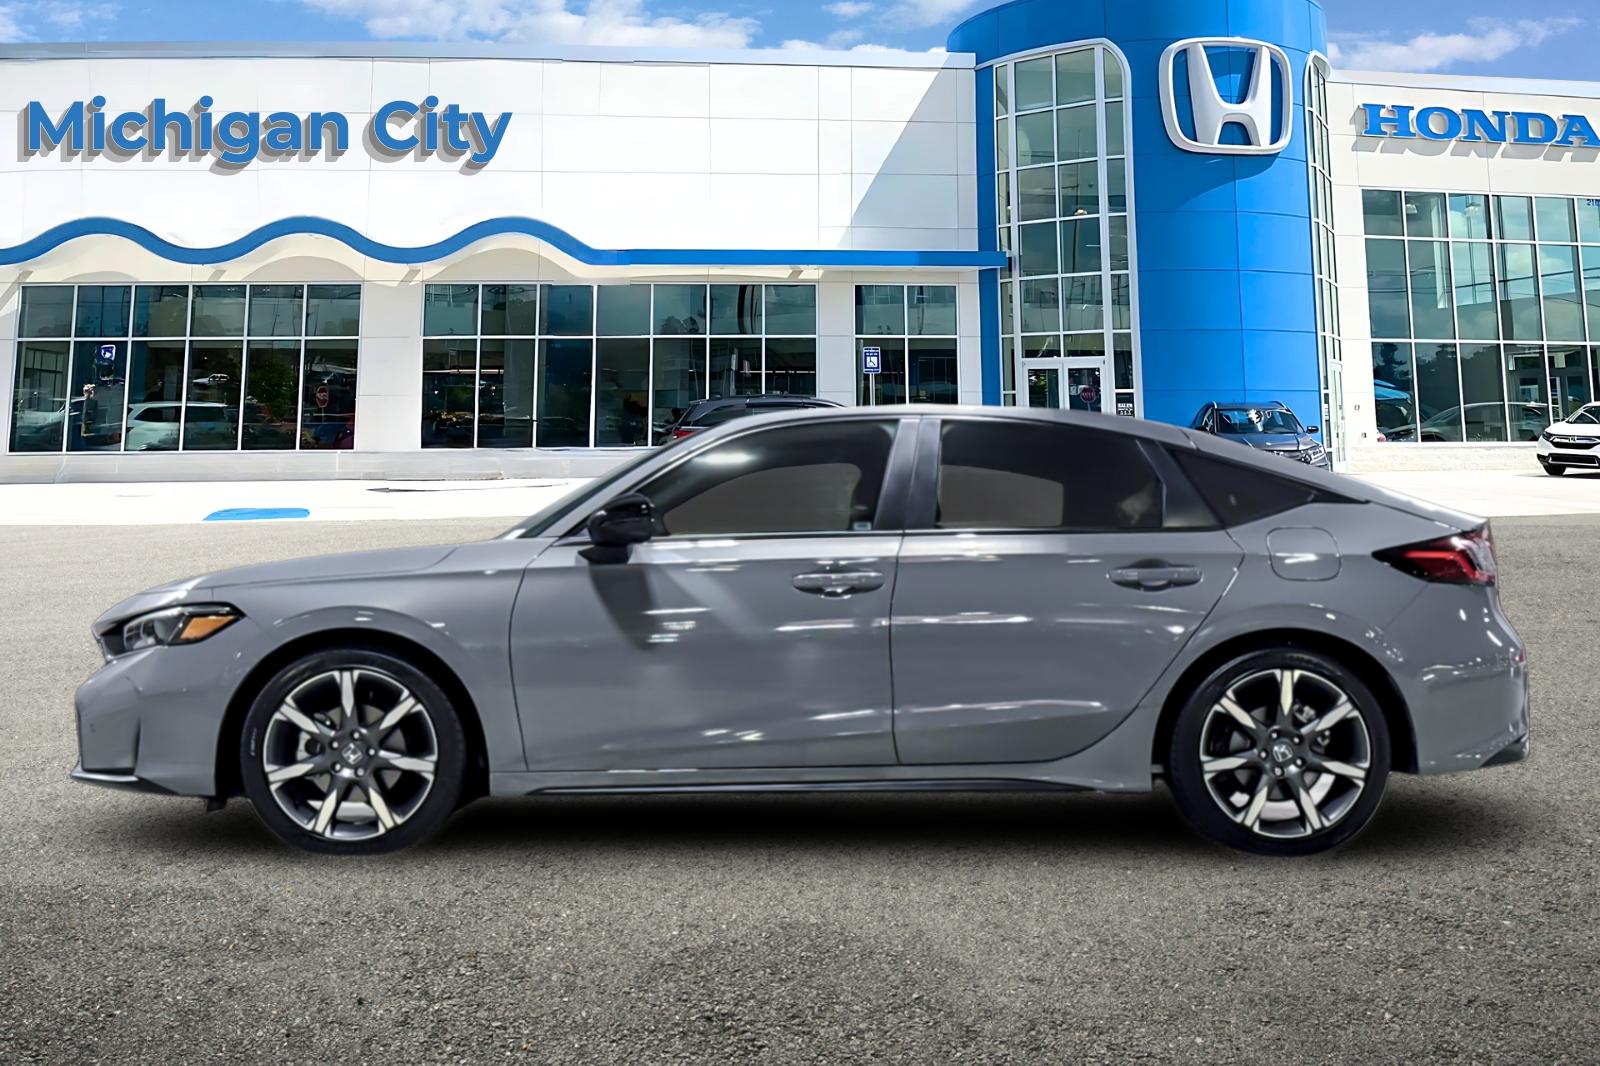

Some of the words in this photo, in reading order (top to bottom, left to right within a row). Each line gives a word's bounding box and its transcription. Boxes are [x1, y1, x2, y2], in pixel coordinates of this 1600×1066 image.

[29, 95, 349, 163] Michigan
[374, 95, 513, 163] City
[1361, 103, 1600, 147] HONDA
